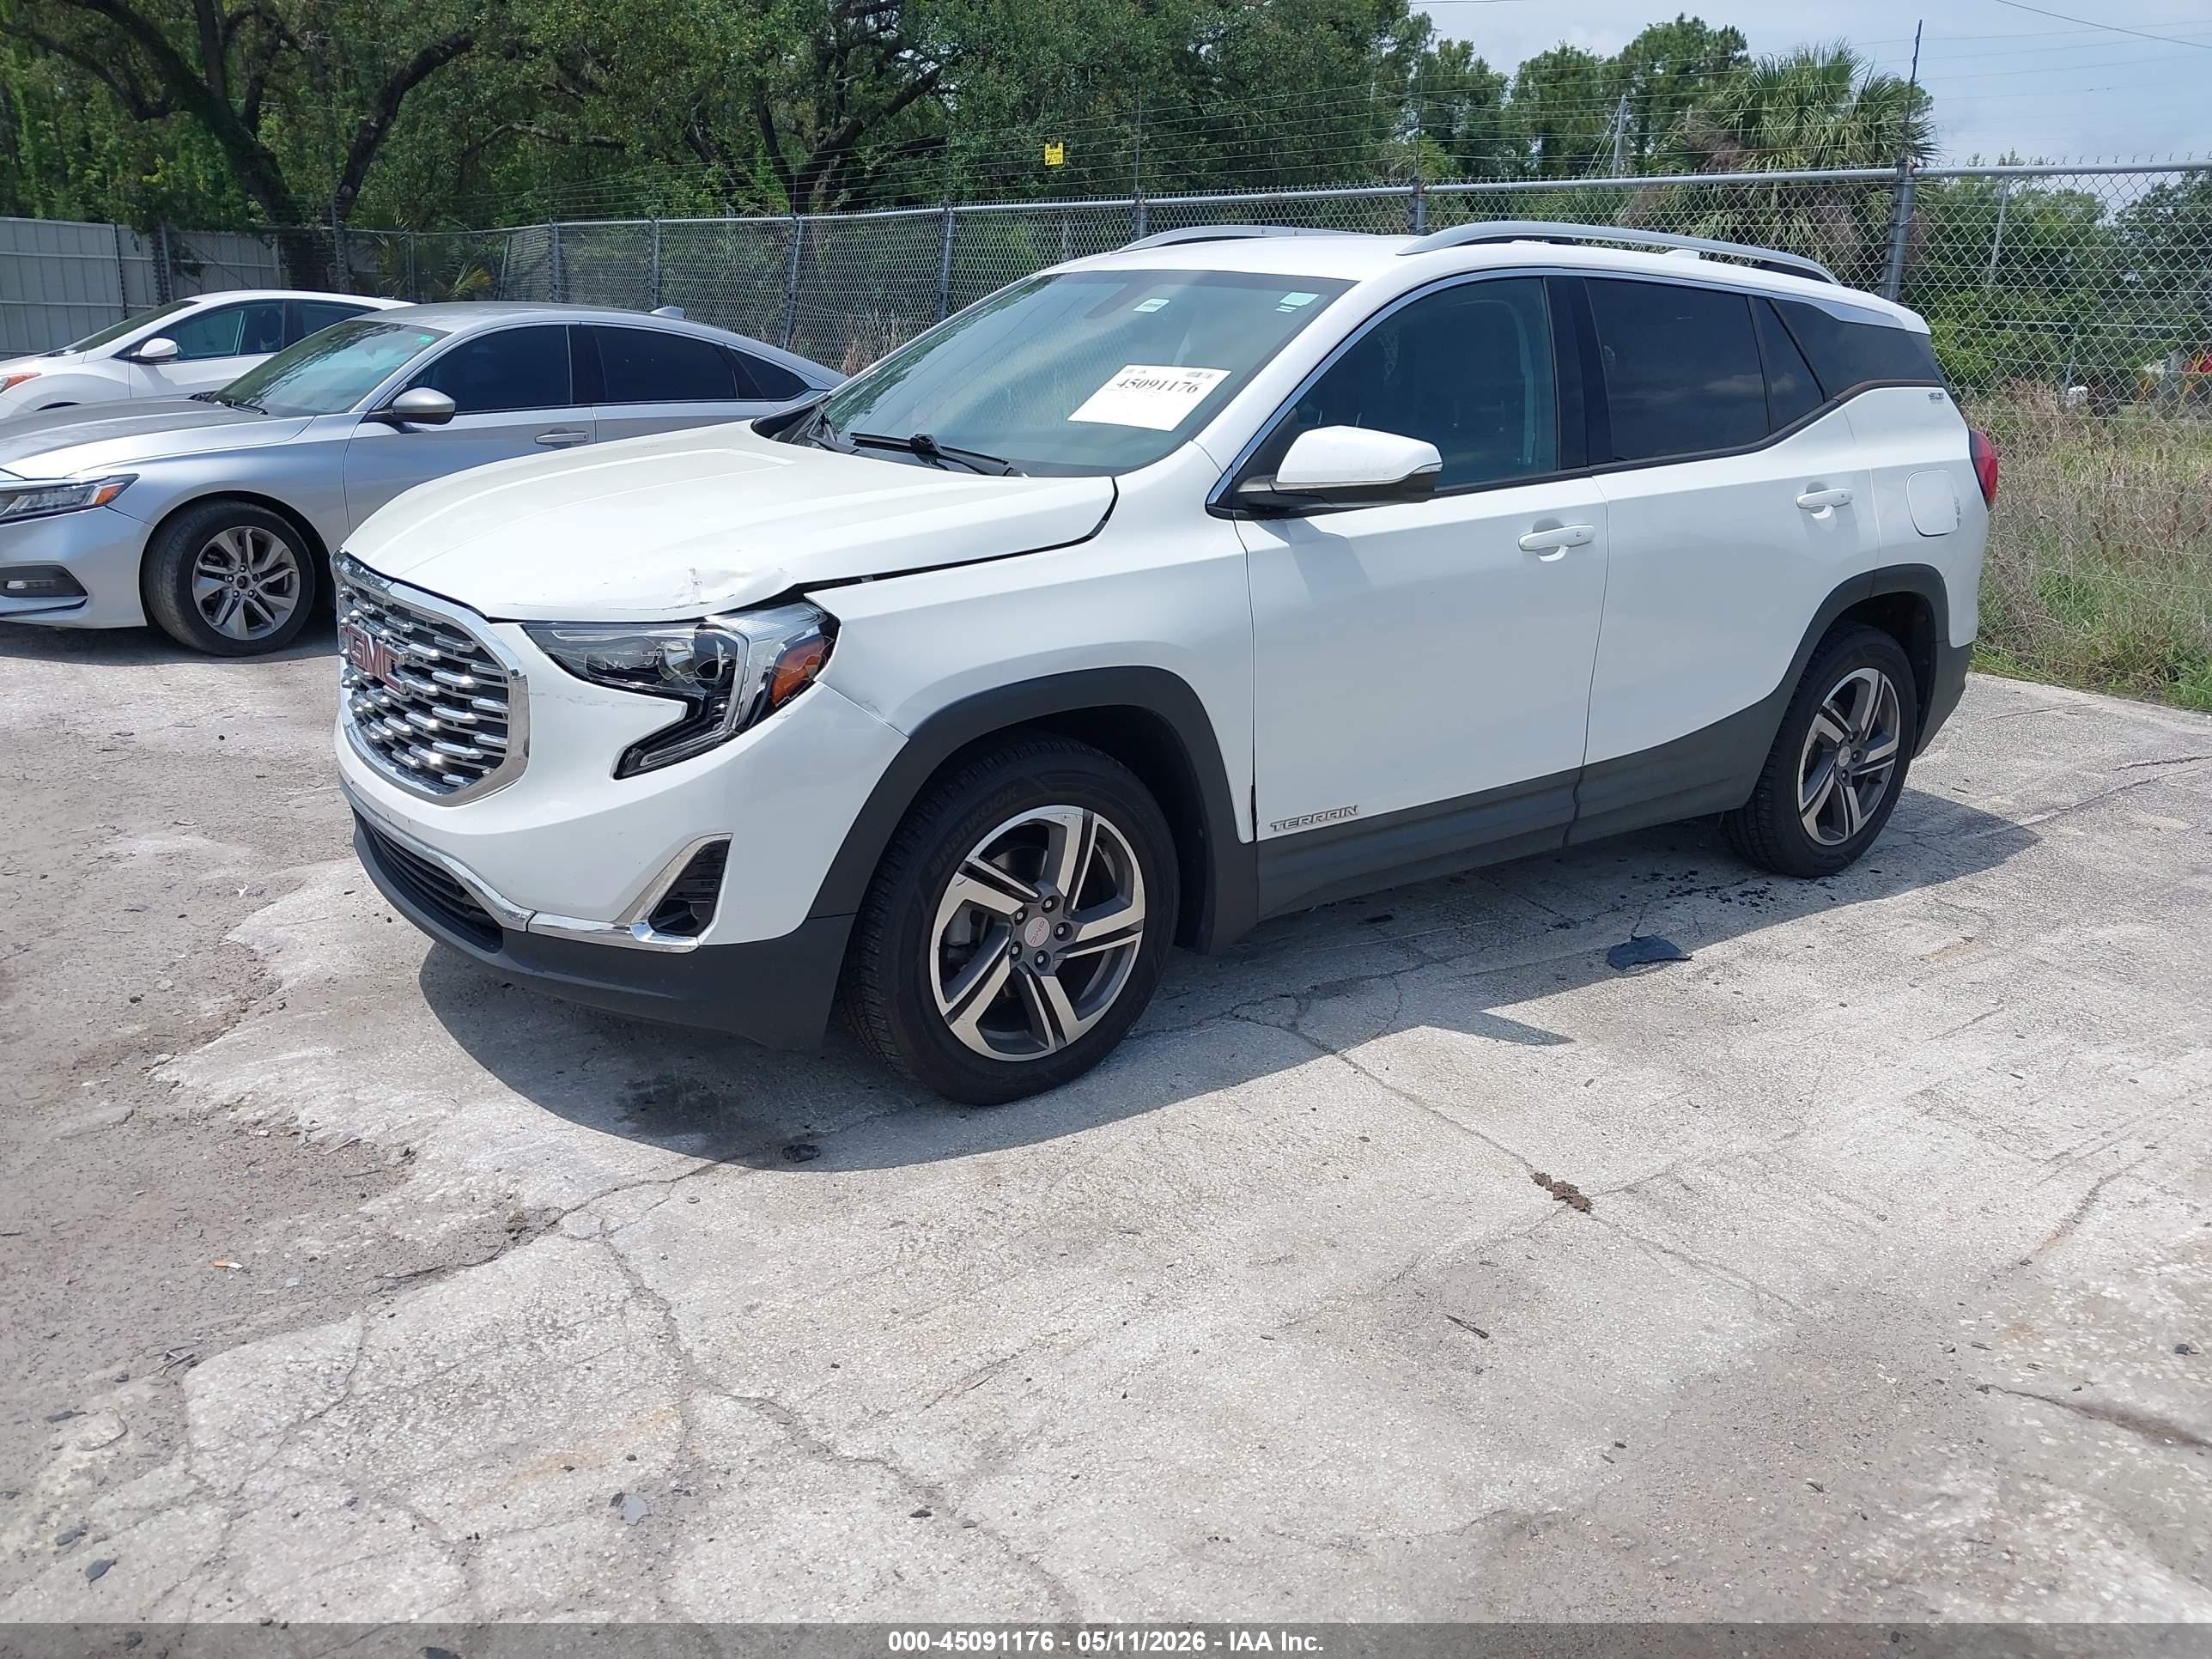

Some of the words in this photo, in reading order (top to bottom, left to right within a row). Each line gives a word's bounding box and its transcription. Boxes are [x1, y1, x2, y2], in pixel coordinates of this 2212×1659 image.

[1116, 378, 1203, 394] 45091176
[348, 624, 410, 695] GMC
[1270, 805, 1359, 832] TERRAIN
[1030, 920, 1045, 945] GMC
